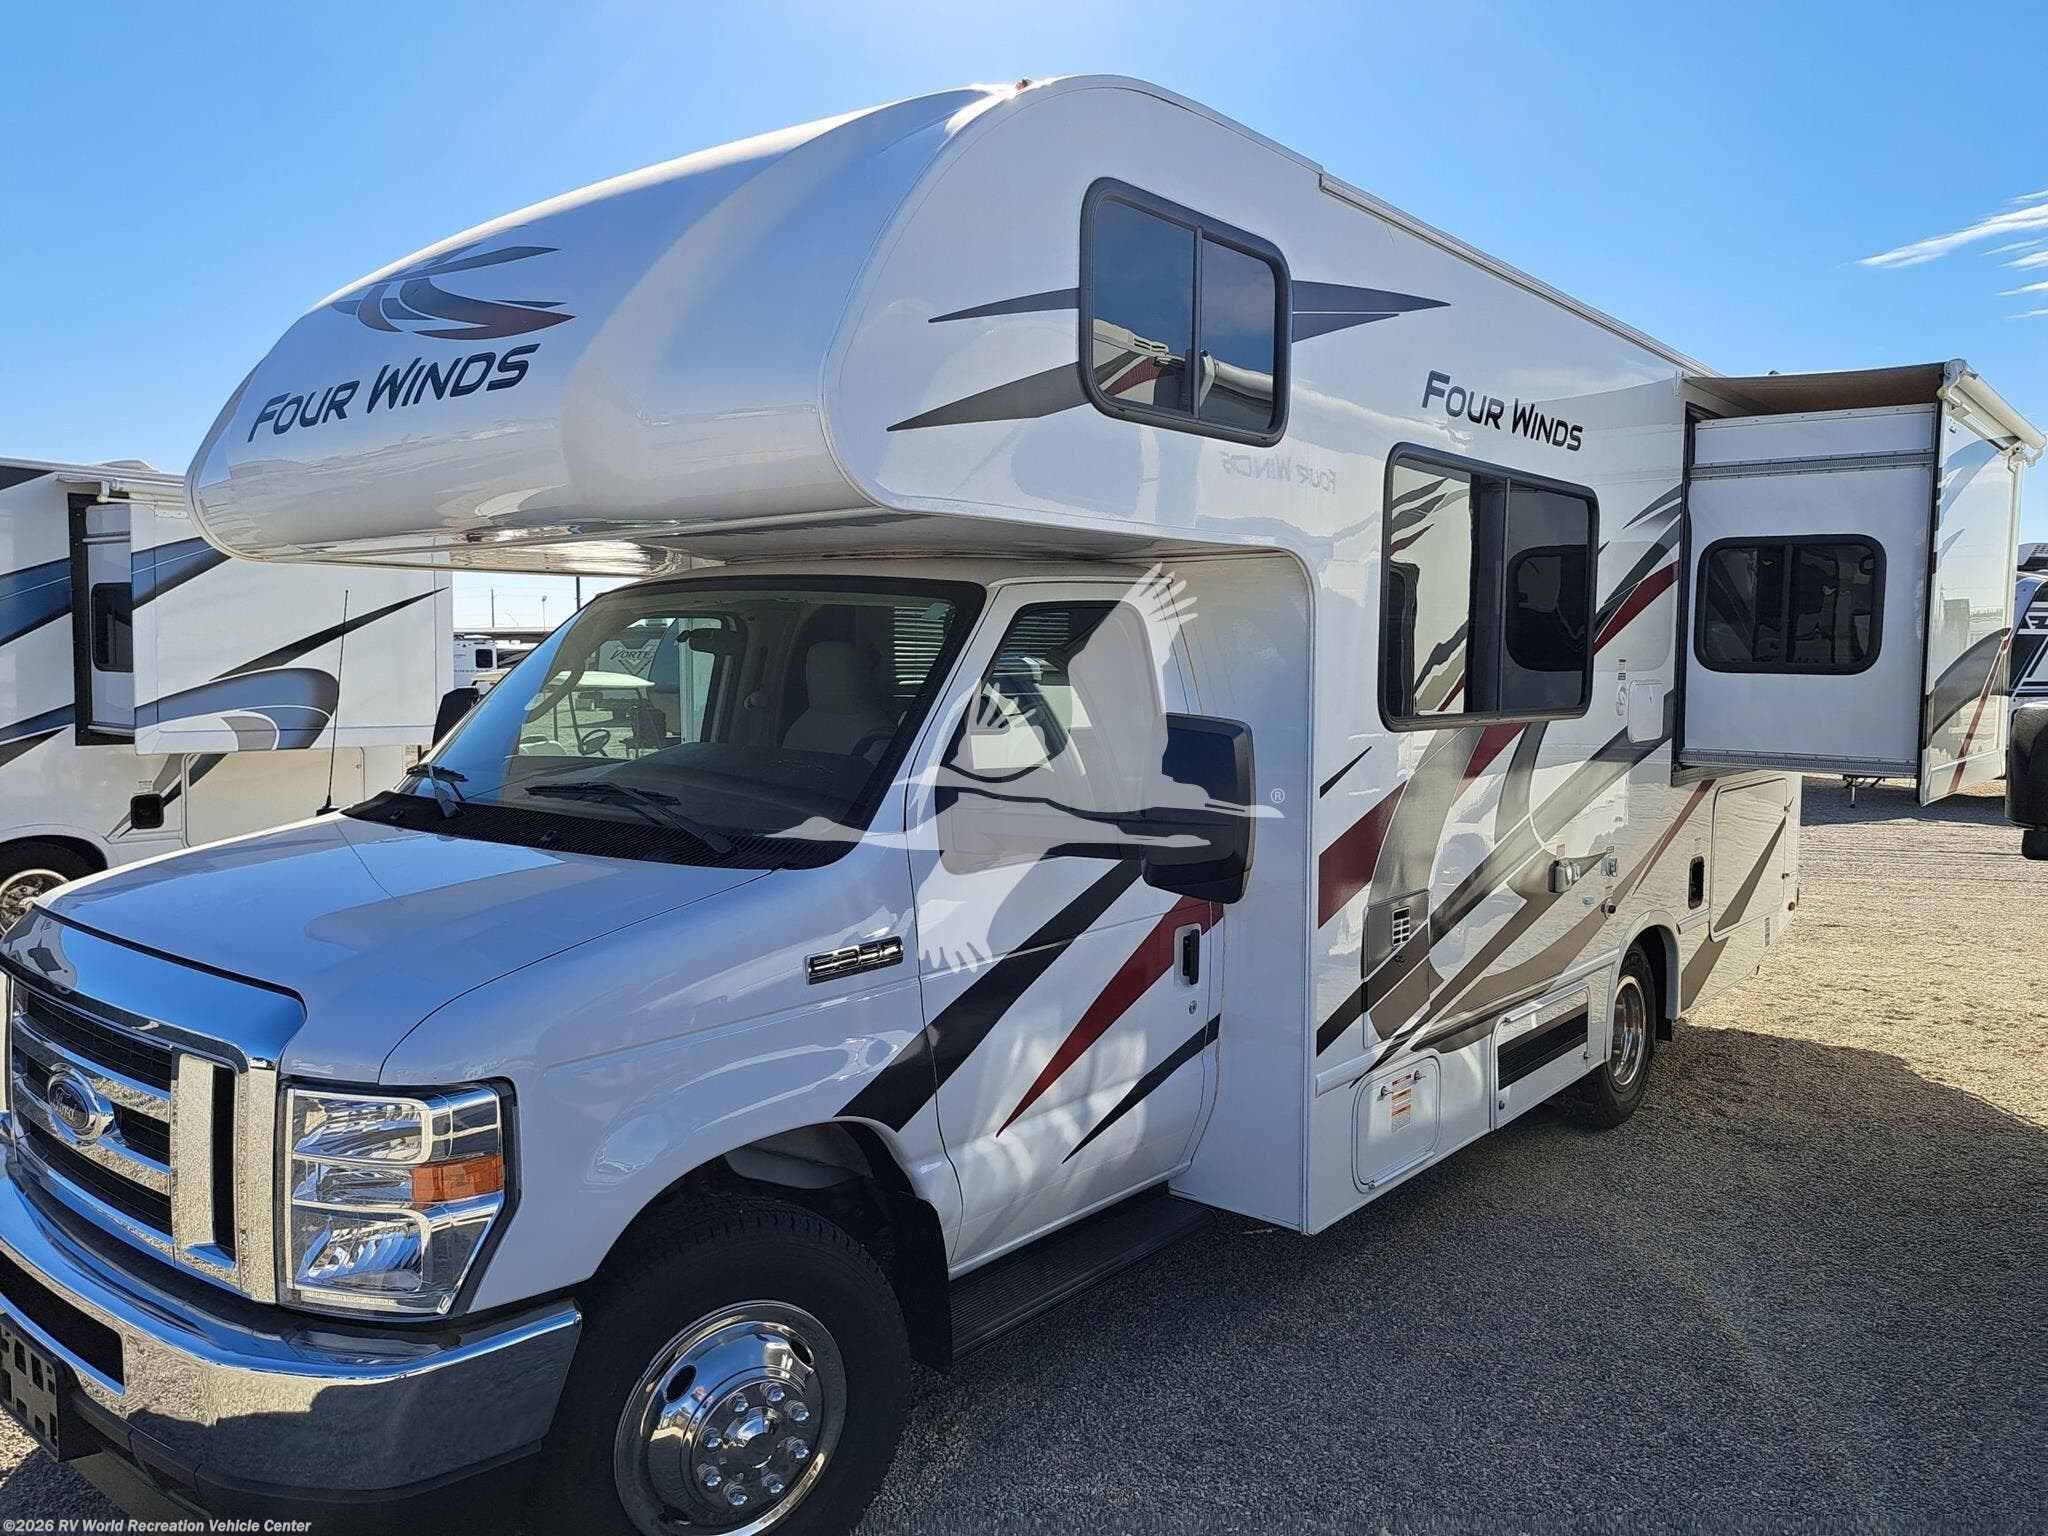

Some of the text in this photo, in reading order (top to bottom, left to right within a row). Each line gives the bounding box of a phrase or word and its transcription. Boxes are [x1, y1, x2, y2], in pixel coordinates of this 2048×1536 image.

[248, 343, 540, 443] FOUR WINDS
[1422, 370, 1584, 452] FOUR WINDS
[609, 649, 655, 661] VORTE
[53, 1087, 77, 1122] Ford
